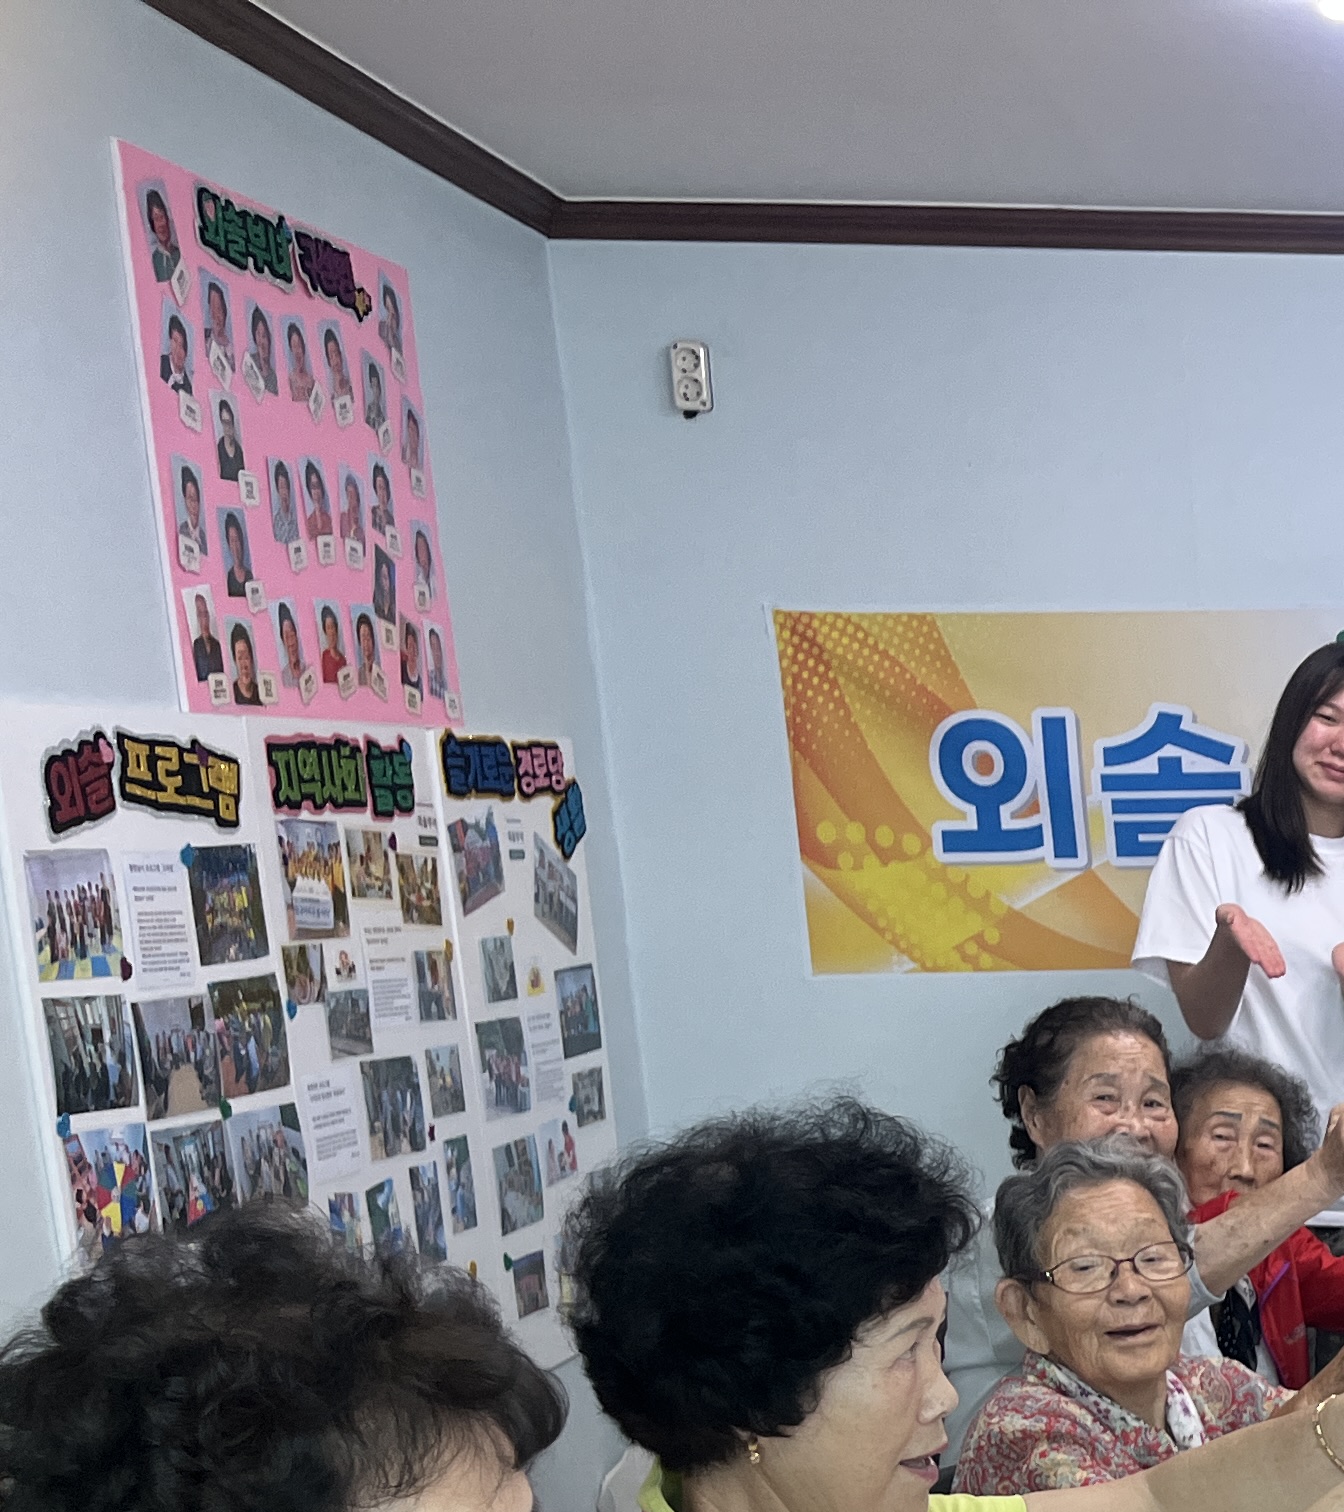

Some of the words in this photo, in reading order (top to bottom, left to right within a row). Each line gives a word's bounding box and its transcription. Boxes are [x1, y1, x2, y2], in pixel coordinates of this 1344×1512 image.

[46, 738, 116, 830] 외솔
[122, 736, 239, 822] 프로그램
[271, 745, 367, 806] 지역사회
[369, 744, 414, 813] 활동
[445, 737, 516, 797] 슬기로운
[516, 745, 566, 796] 경로당
[935, 703, 1247, 863] 외솔
